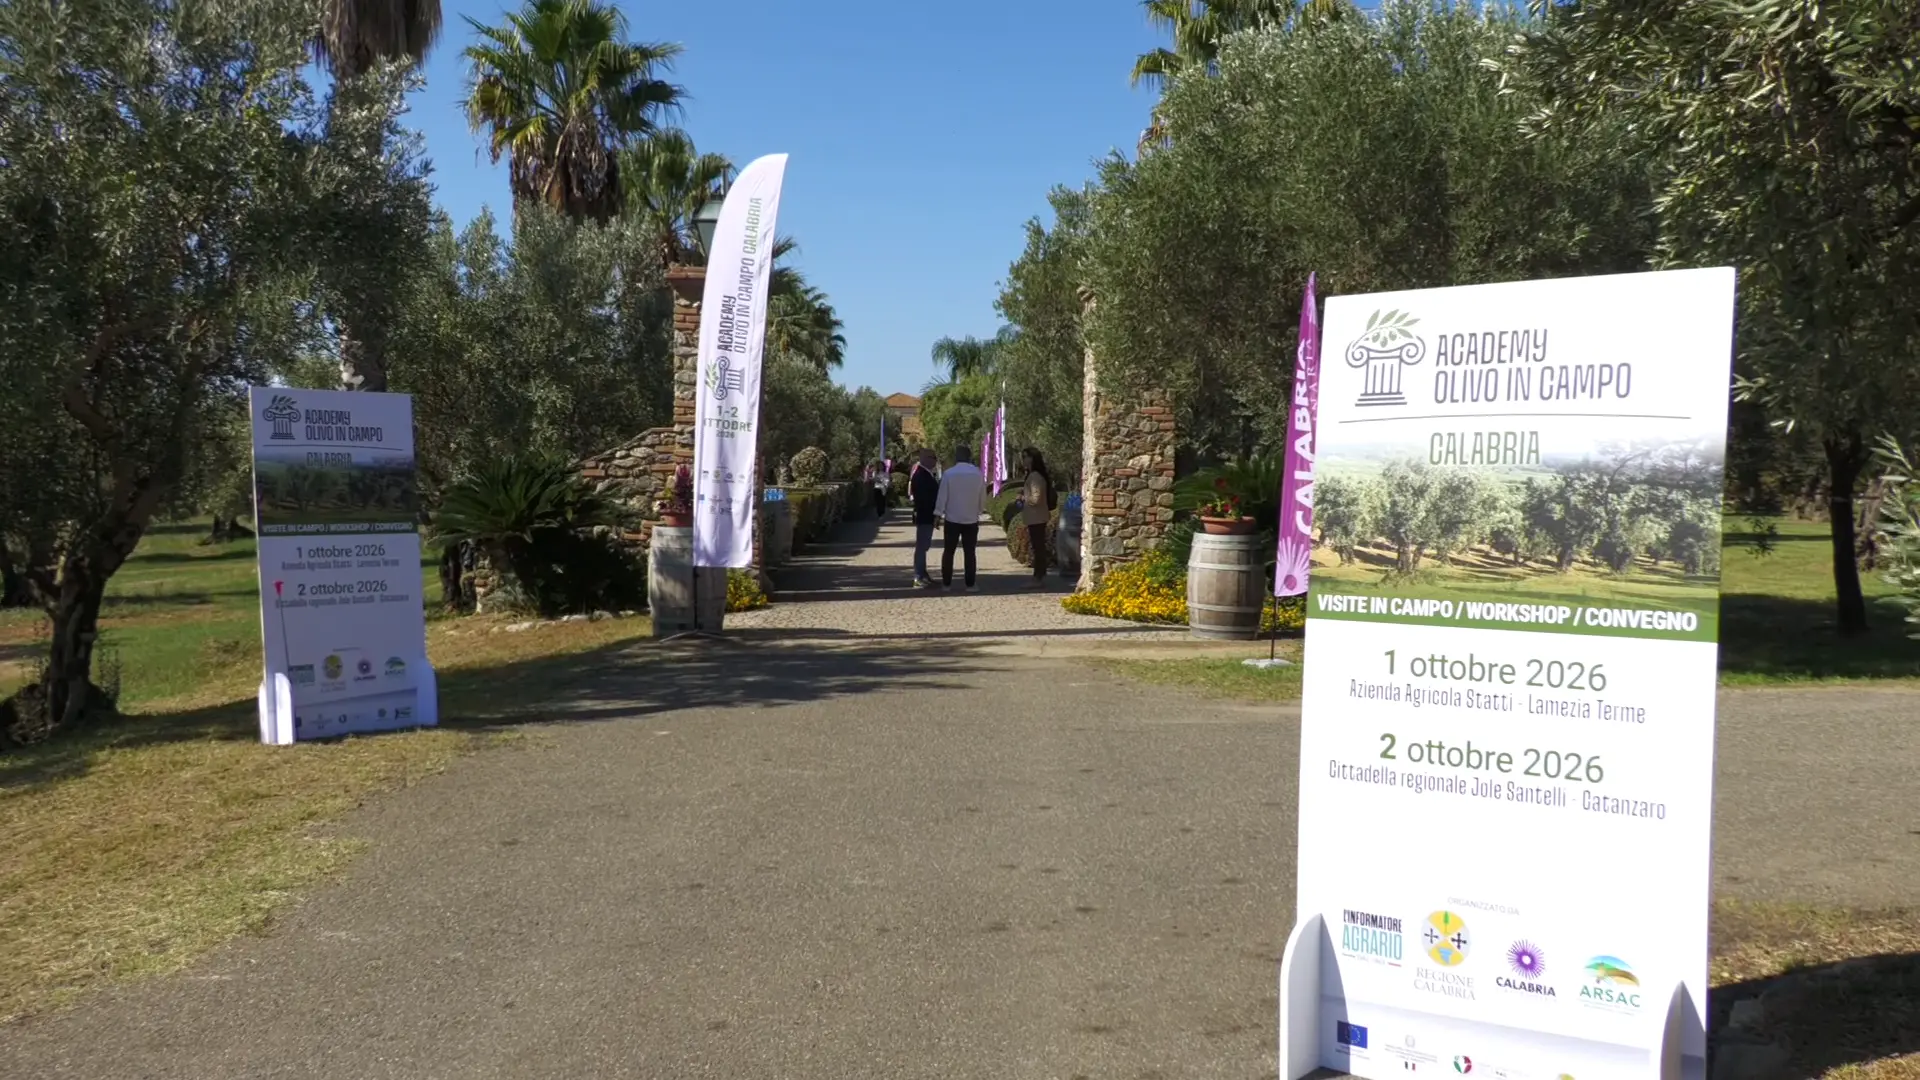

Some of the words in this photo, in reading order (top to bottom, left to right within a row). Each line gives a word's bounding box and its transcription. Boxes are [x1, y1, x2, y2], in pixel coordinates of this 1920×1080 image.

[742, 197, 763, 254] CALABRIA
[738, 257, 755, 302] CAMPO
[717, 295, 736, 351] ACADEMY
[737, 303, 751, 318] IN
[733, 319, 751, 353] OLIVO
[1435, 328, 1547, 367] ACADEMY
[1434, 367, 1498, 404] OLIVO
[1506, 366, 1531, 402] IN
[1539, 362, 1632, 400] CAMPO
[305, 409, 351, 426] ACADEMY
[717, 405, 738, 418] 1-2
[305, 425, 333, 441] OLIVO
[335, 425, 346, 441] IN
[348, 426, 383, 442] CAMPO
[1294, 338, 1316, 536] CALABRIA
[1429, 430, 1540, 466] CALABRIA
[306, 451, 352, 468] CALABRIA
[296, 547, 302, 558] 1
[308, 545, 352, 558] ottobre
[355, 544, 385, 557] 2026
[297, 583, 306, 596] 2
[310, 581, 354, 595] ottobre
[357, 580, 388, 593] 2026
[1317, 594, 1368, 614] VISITE
[1370, 598, 1387, 615] IN
[1390, 599, 1453, 619] CAMPO
[1455, 601, 1463, 620] /
[1466, 601, 1570, 625] WORKSHOP
[1573, 607, 1582, 626] /
[1585, 607, 1697, 632] CONVEGNO
[1384, 650, 1395, 675] 1
[1410, 653, 1516, 684] ottobre
[1526, 659, 1607, 692] 2026
[1350, 678, 1401, 702] Azienda
[1404, 683, 1462, 708] Agricola
[1466, 688, 1513, 712] Statti
[1528, 694, 1591, 719] Lamezia
[1596, 699, 1646, 724] Terme
[1379, 733, 1397, 760] 2
[1407, 741, 1513, 773] ottobre
[1523, 748, 1604, 783] 2026
[1328, 759, 1397, 786] Cittadella
[1401, 772, 1467, 795] regionale
[1471, 776, 1502, 800] Jole
[1506, 781, 1567, 808] Santelli
[1582, 790, 1666, 820] Catanzaro
[1342, 923, 1402, 960] AGRARIO
[1413, 978, 1476, 1000] CALABRIA
[1416, 967, 1474, 987] REGIONE
[1496, 976, 1556, 997] CALABRIA
[1579, 985, 1641, 1008] ARSAC
